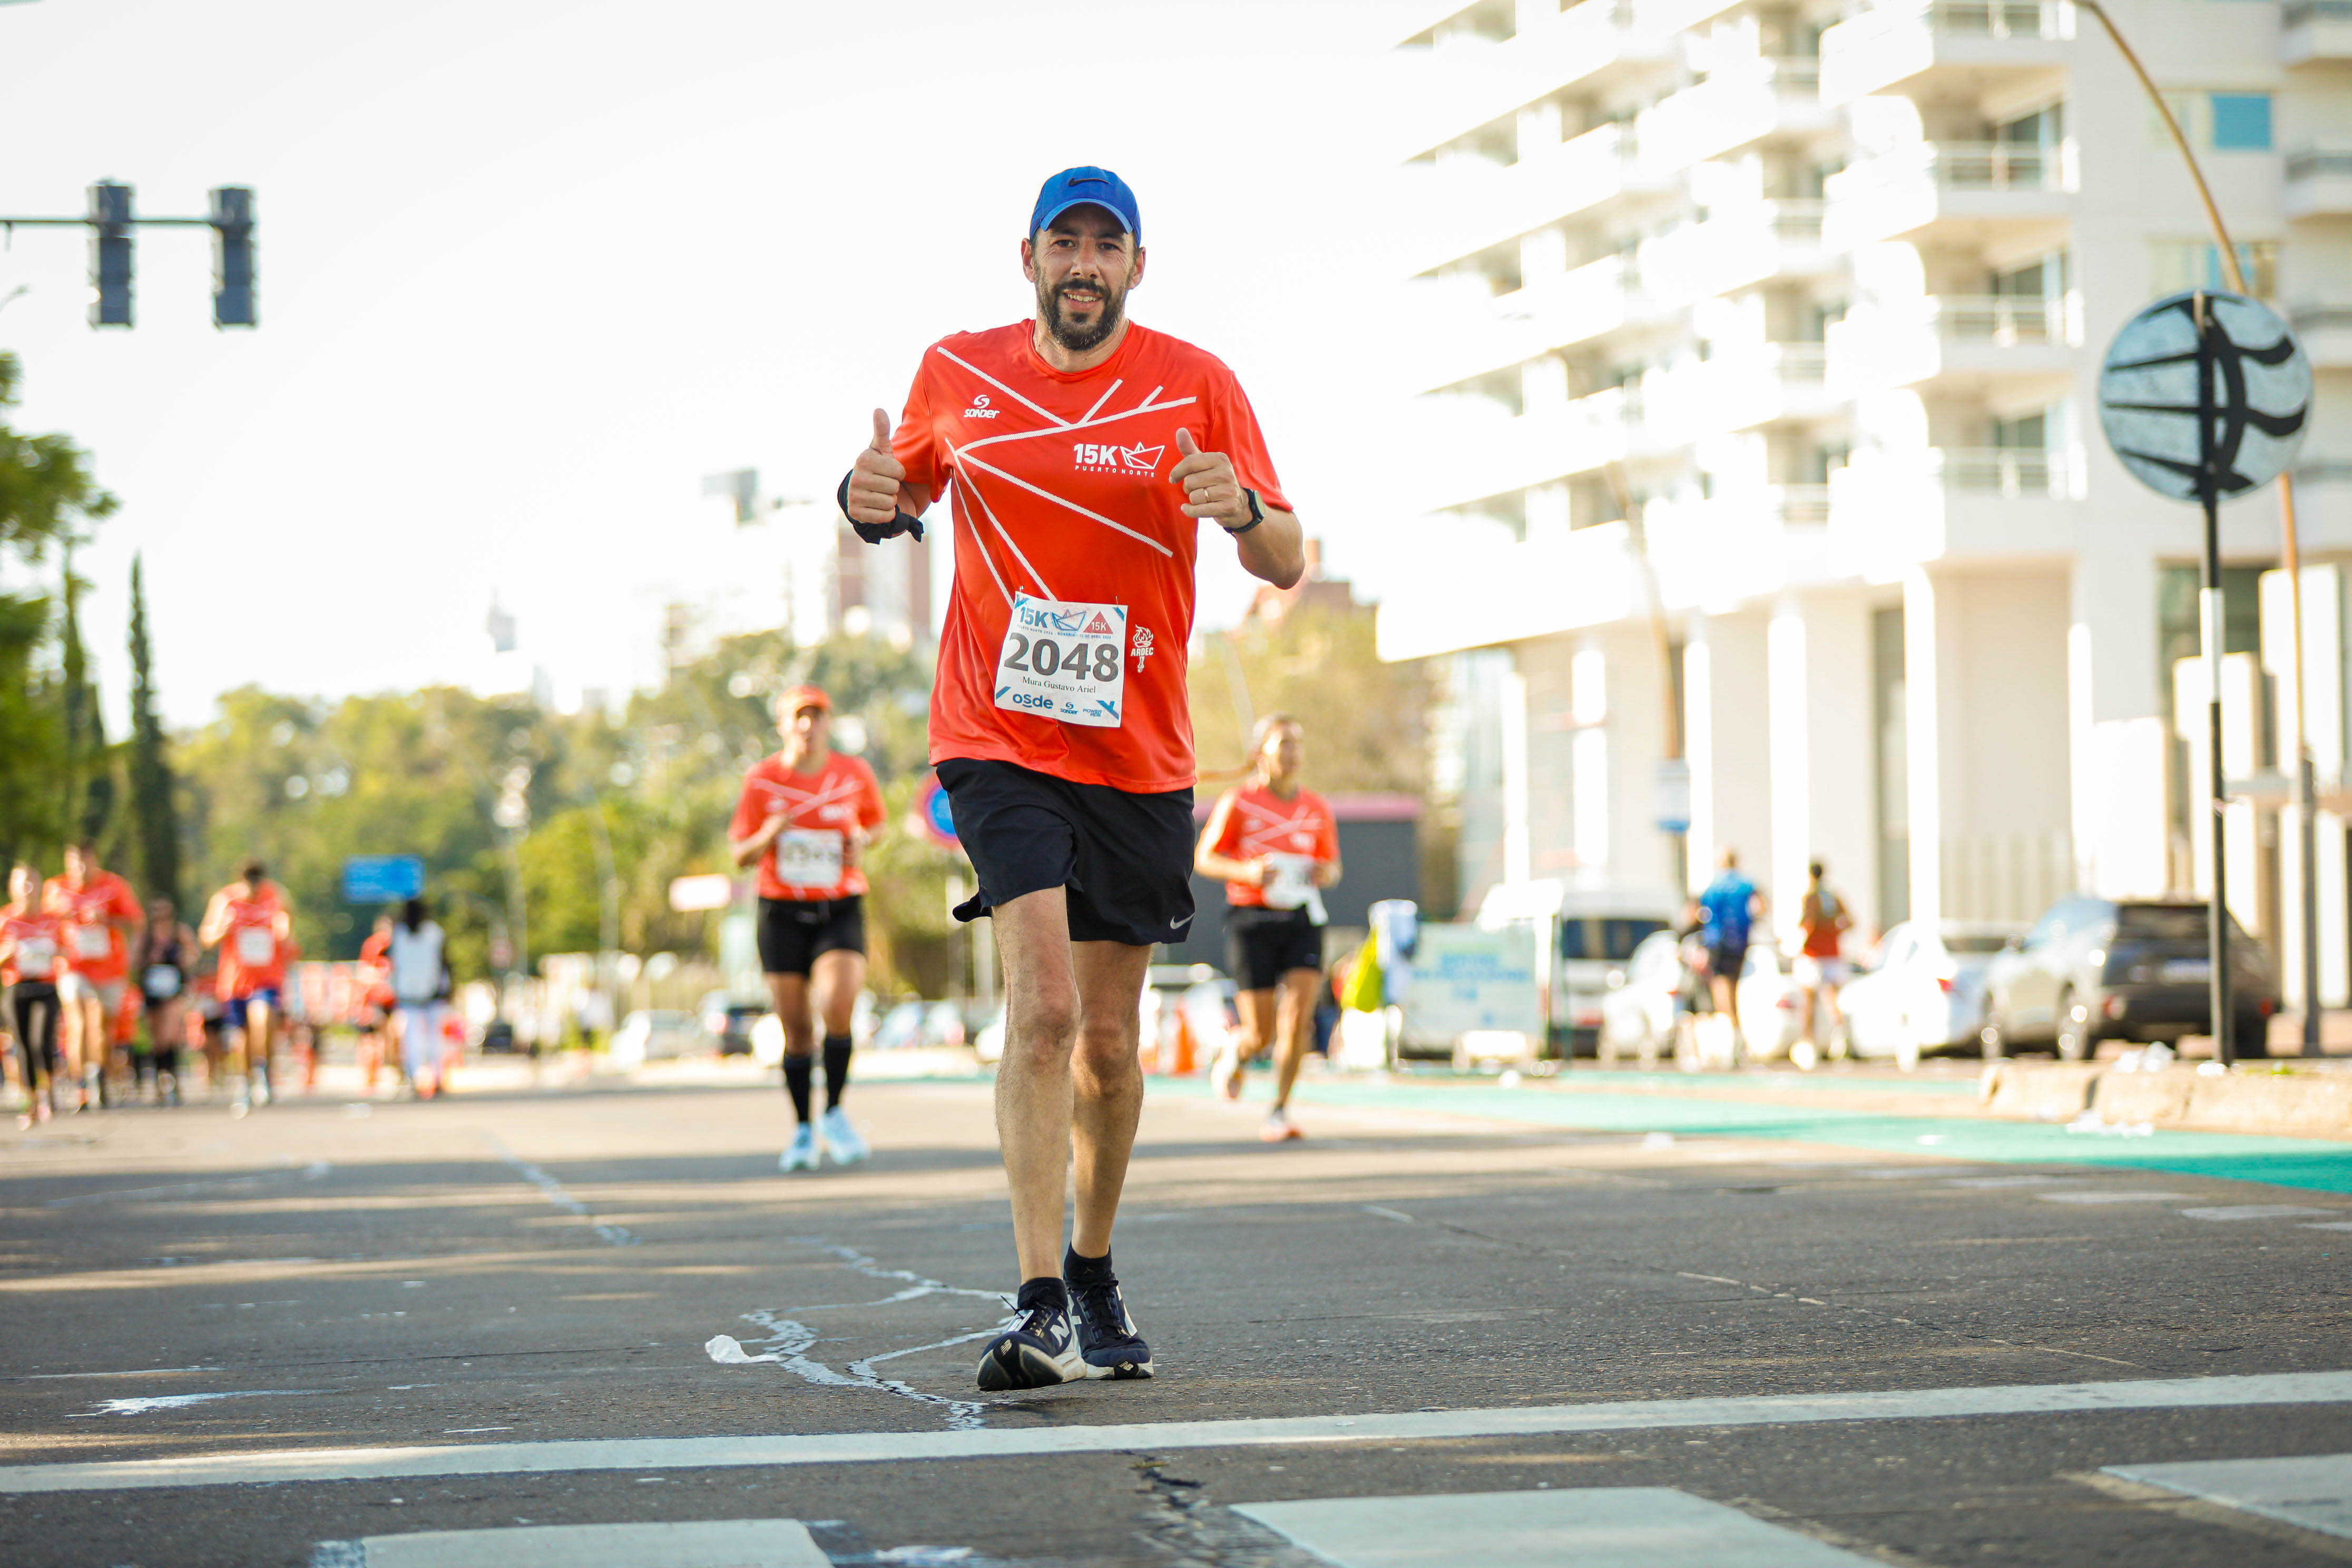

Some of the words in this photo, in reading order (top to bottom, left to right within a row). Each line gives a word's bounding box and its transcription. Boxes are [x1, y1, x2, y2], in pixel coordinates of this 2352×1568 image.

[1074, 444, 1119, 466] 15K
[1121, 469, 1155, 477] NORTE
[1020, 606, 1049, 628] 15K
[1091, 622, 1106, 631] 15K
[1004, 632, 1119, 682] 2048
[1130, 647, 1154, 656] ARDEC
[1022, 676, 1042, 686] Mura
[1044, 681, 1075, 692] Gustavo
[1012, 693, 1054, 709] osde
